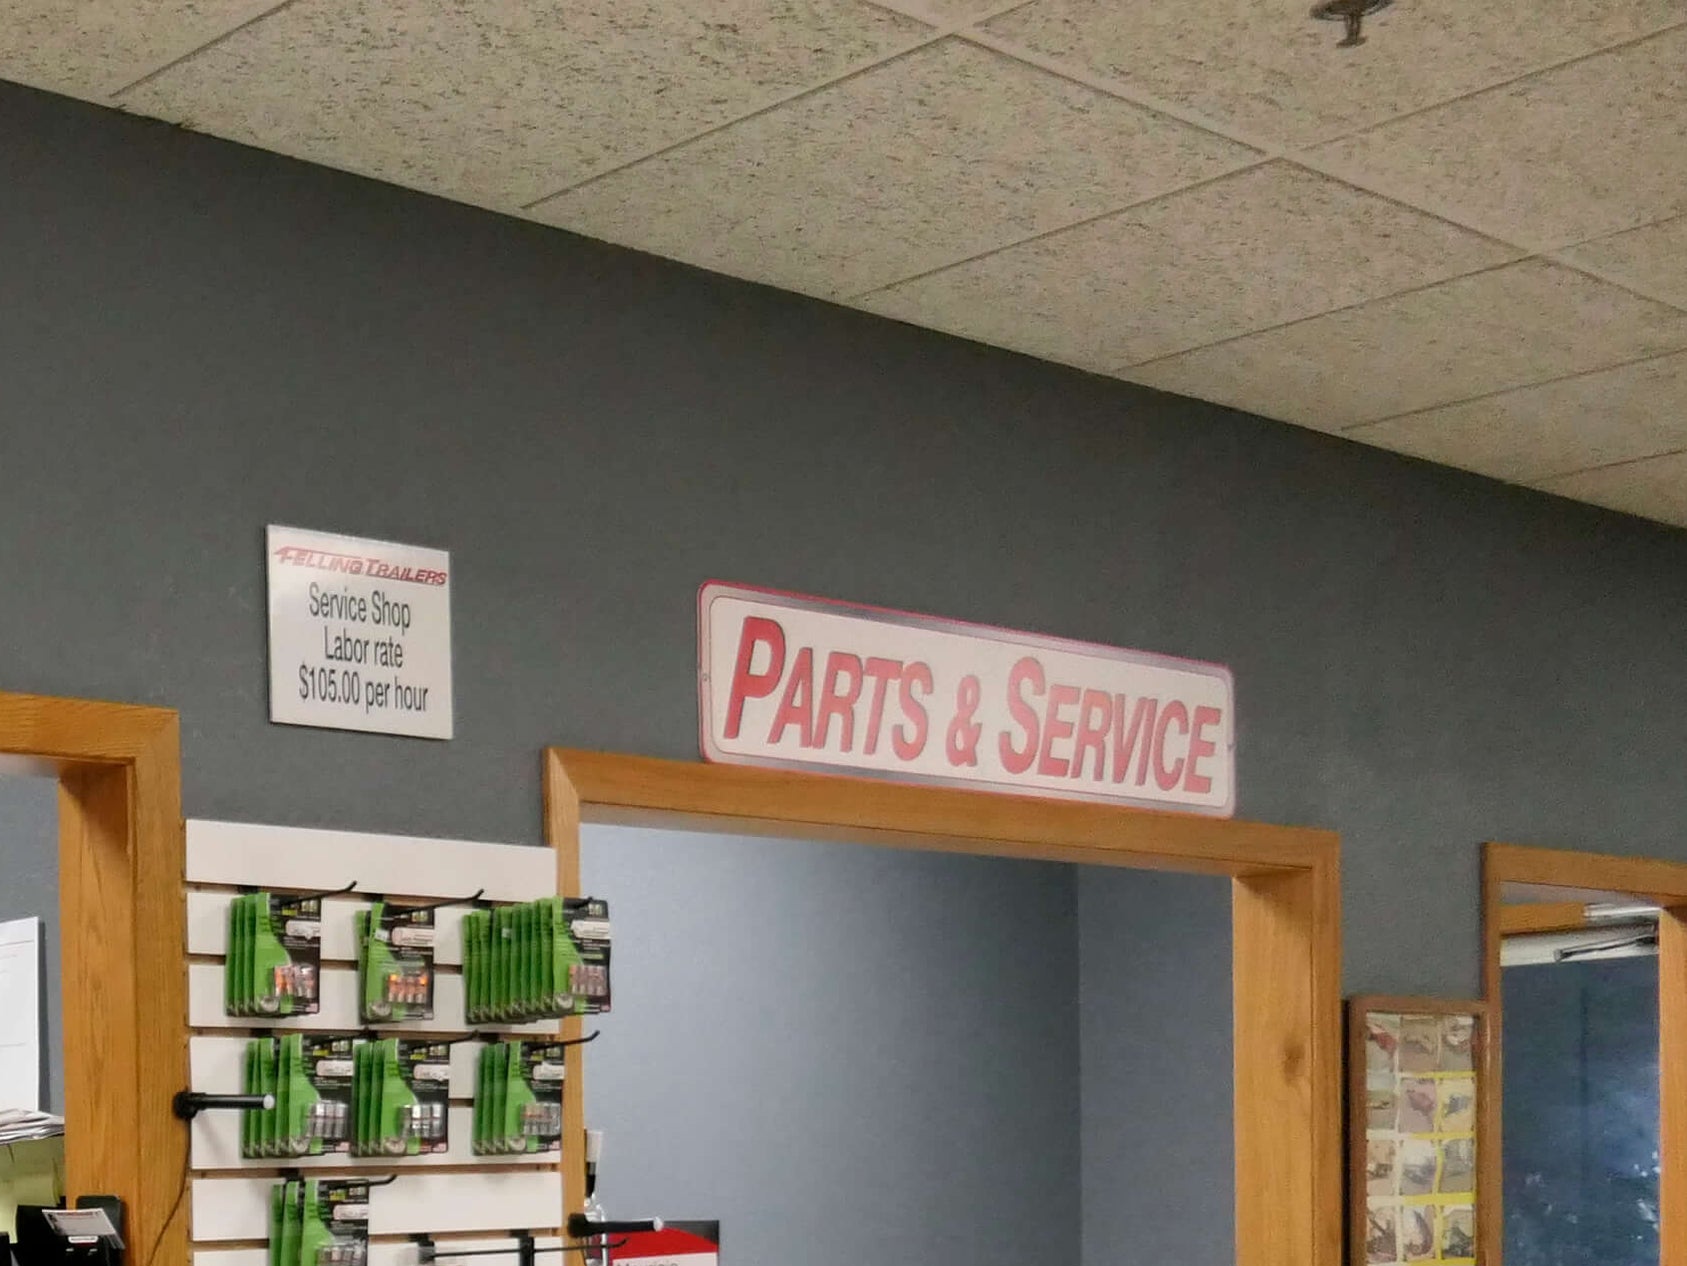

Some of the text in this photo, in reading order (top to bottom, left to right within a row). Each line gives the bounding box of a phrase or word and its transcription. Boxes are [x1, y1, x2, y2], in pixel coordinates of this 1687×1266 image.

[363, 558, 448, 586] TRAILERS
[309, 581, 411, 636] Service Shop
[324, 625, 404, 669] Labor rate
[299, 661, 429, 714] $105.00 per hour
[723, 615, 1222, 795] PARTS & SERVICE
